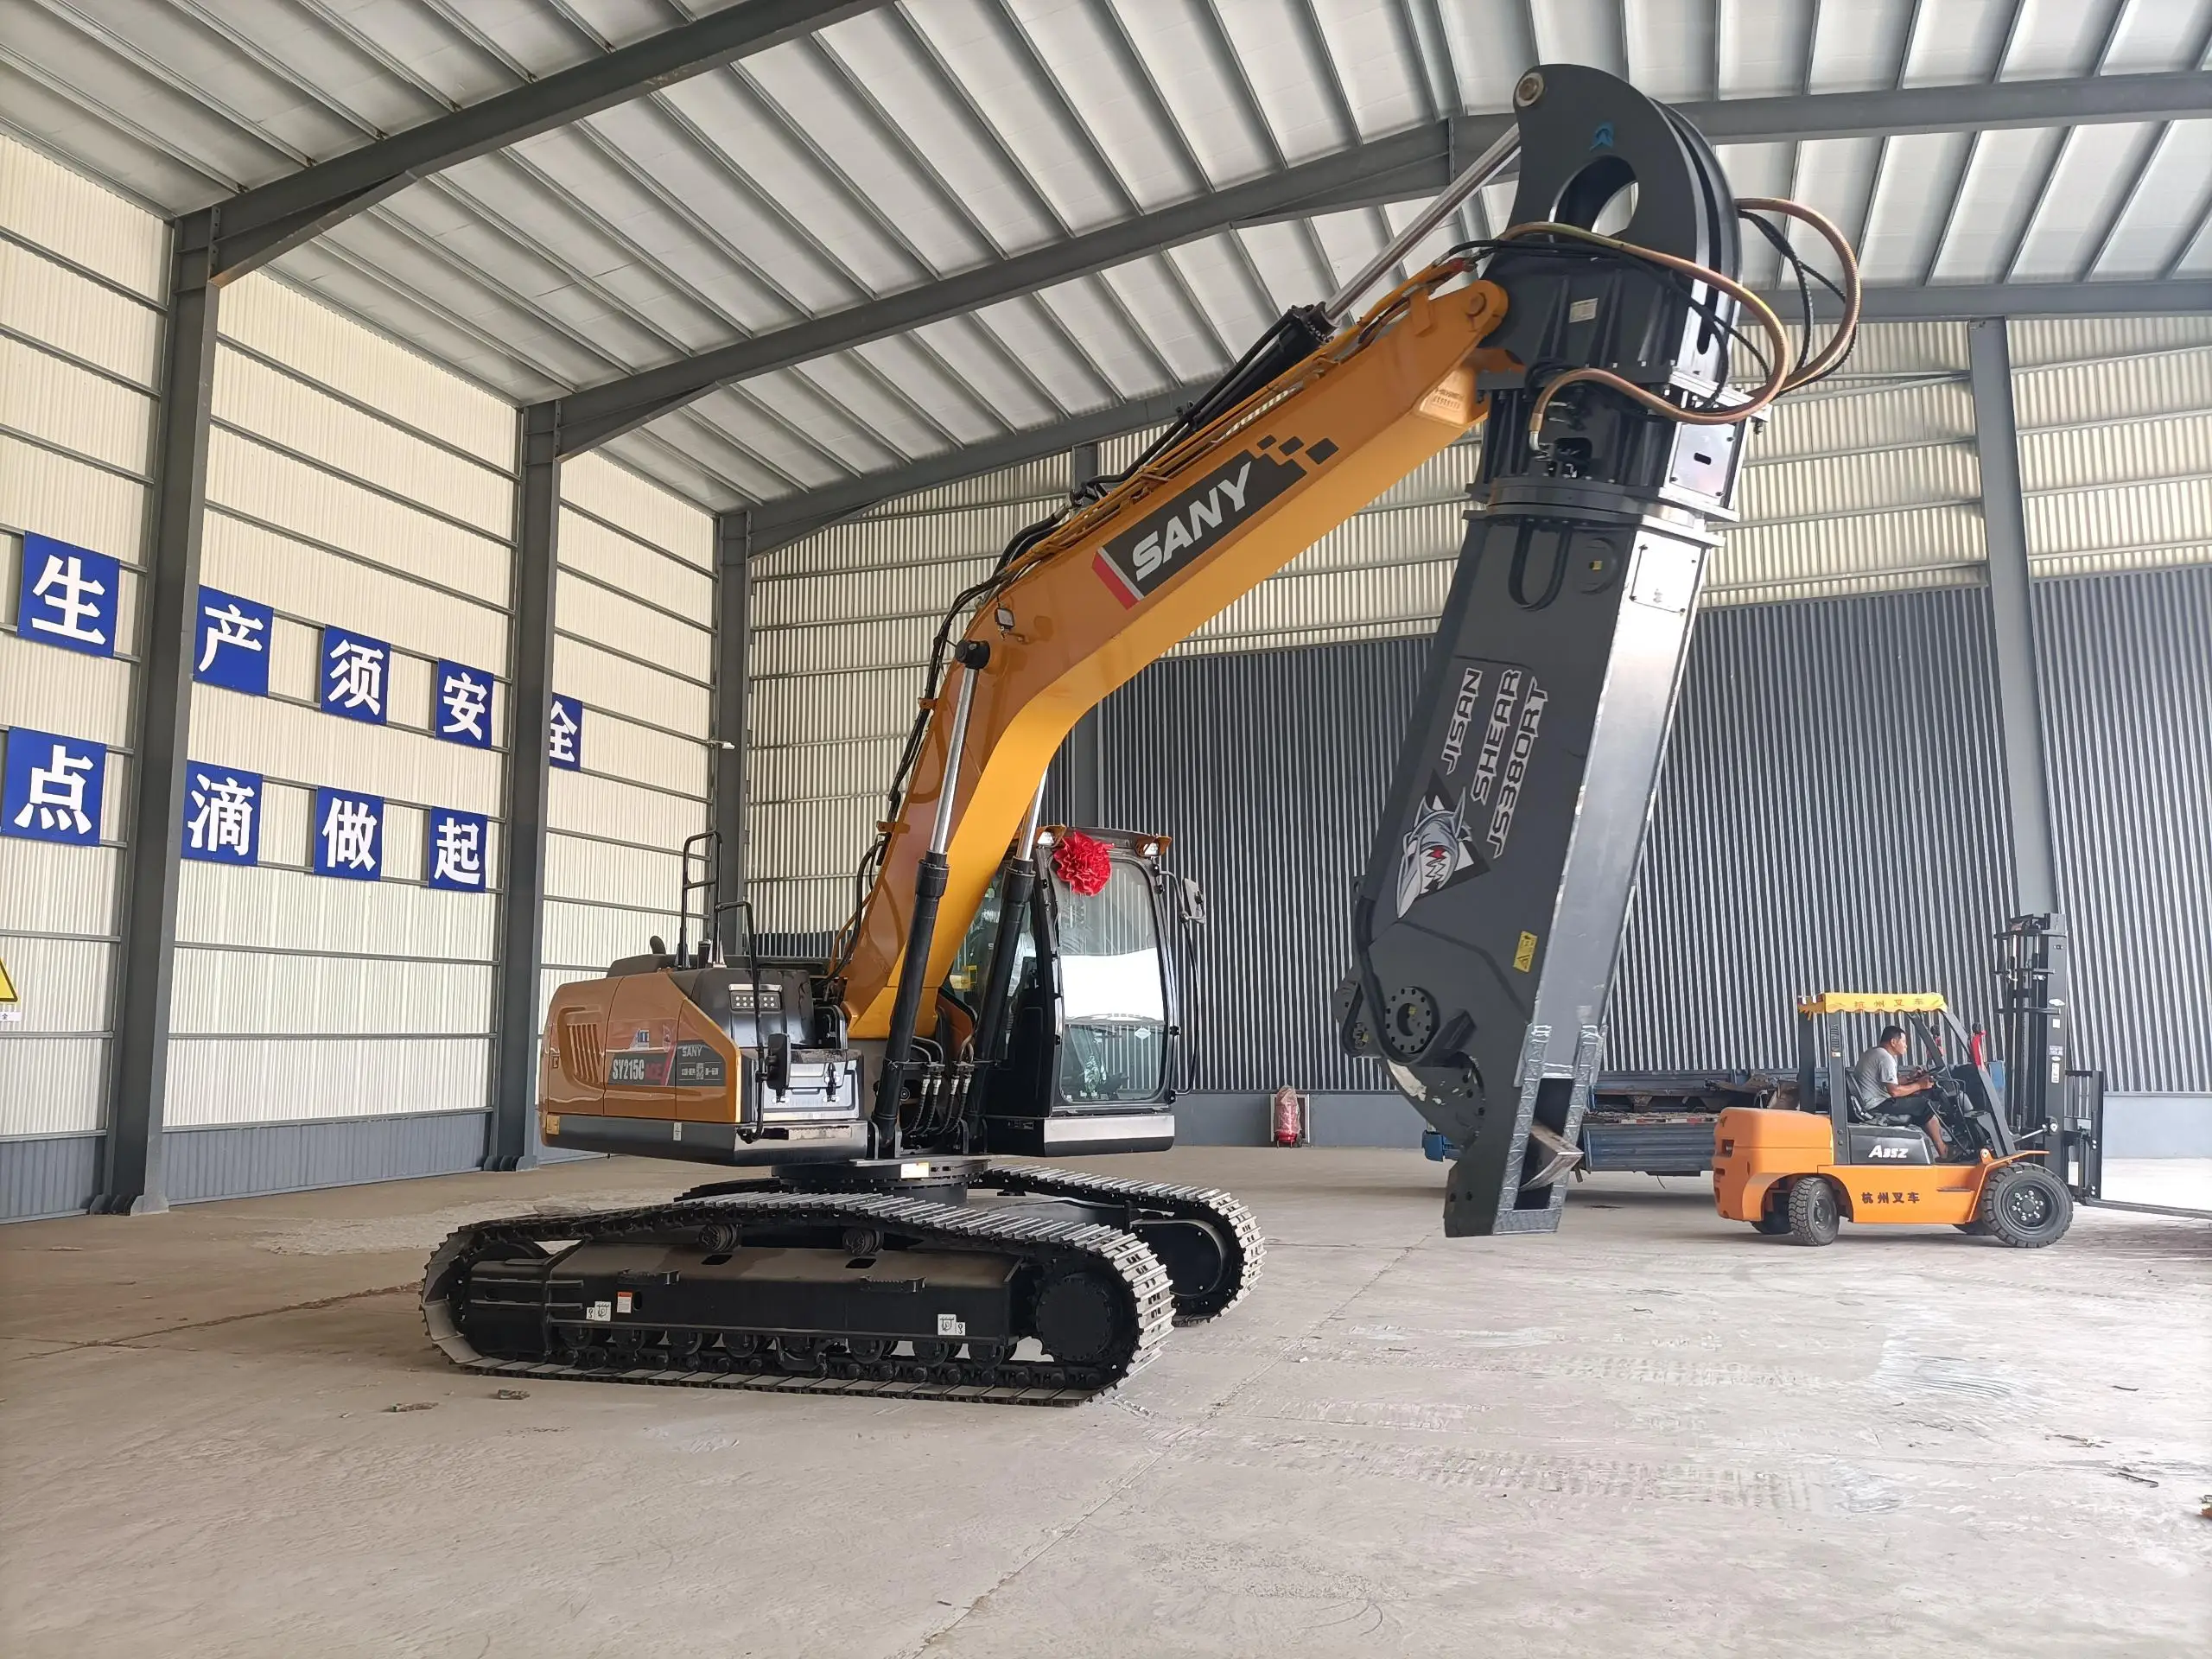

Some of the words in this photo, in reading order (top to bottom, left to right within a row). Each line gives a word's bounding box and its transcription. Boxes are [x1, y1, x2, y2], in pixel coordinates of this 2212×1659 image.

[1132, 461, 1252, 582] SANY
[1441, 667, 1483, 775] JISAN
[1470, 669, 1522, 805] SHEAR
[612, 1058, 645, 1080] SY215C
[682, 1046, 702, 1057] SANY
[1861, 1192, 1920, 1204] 杭州叉车
